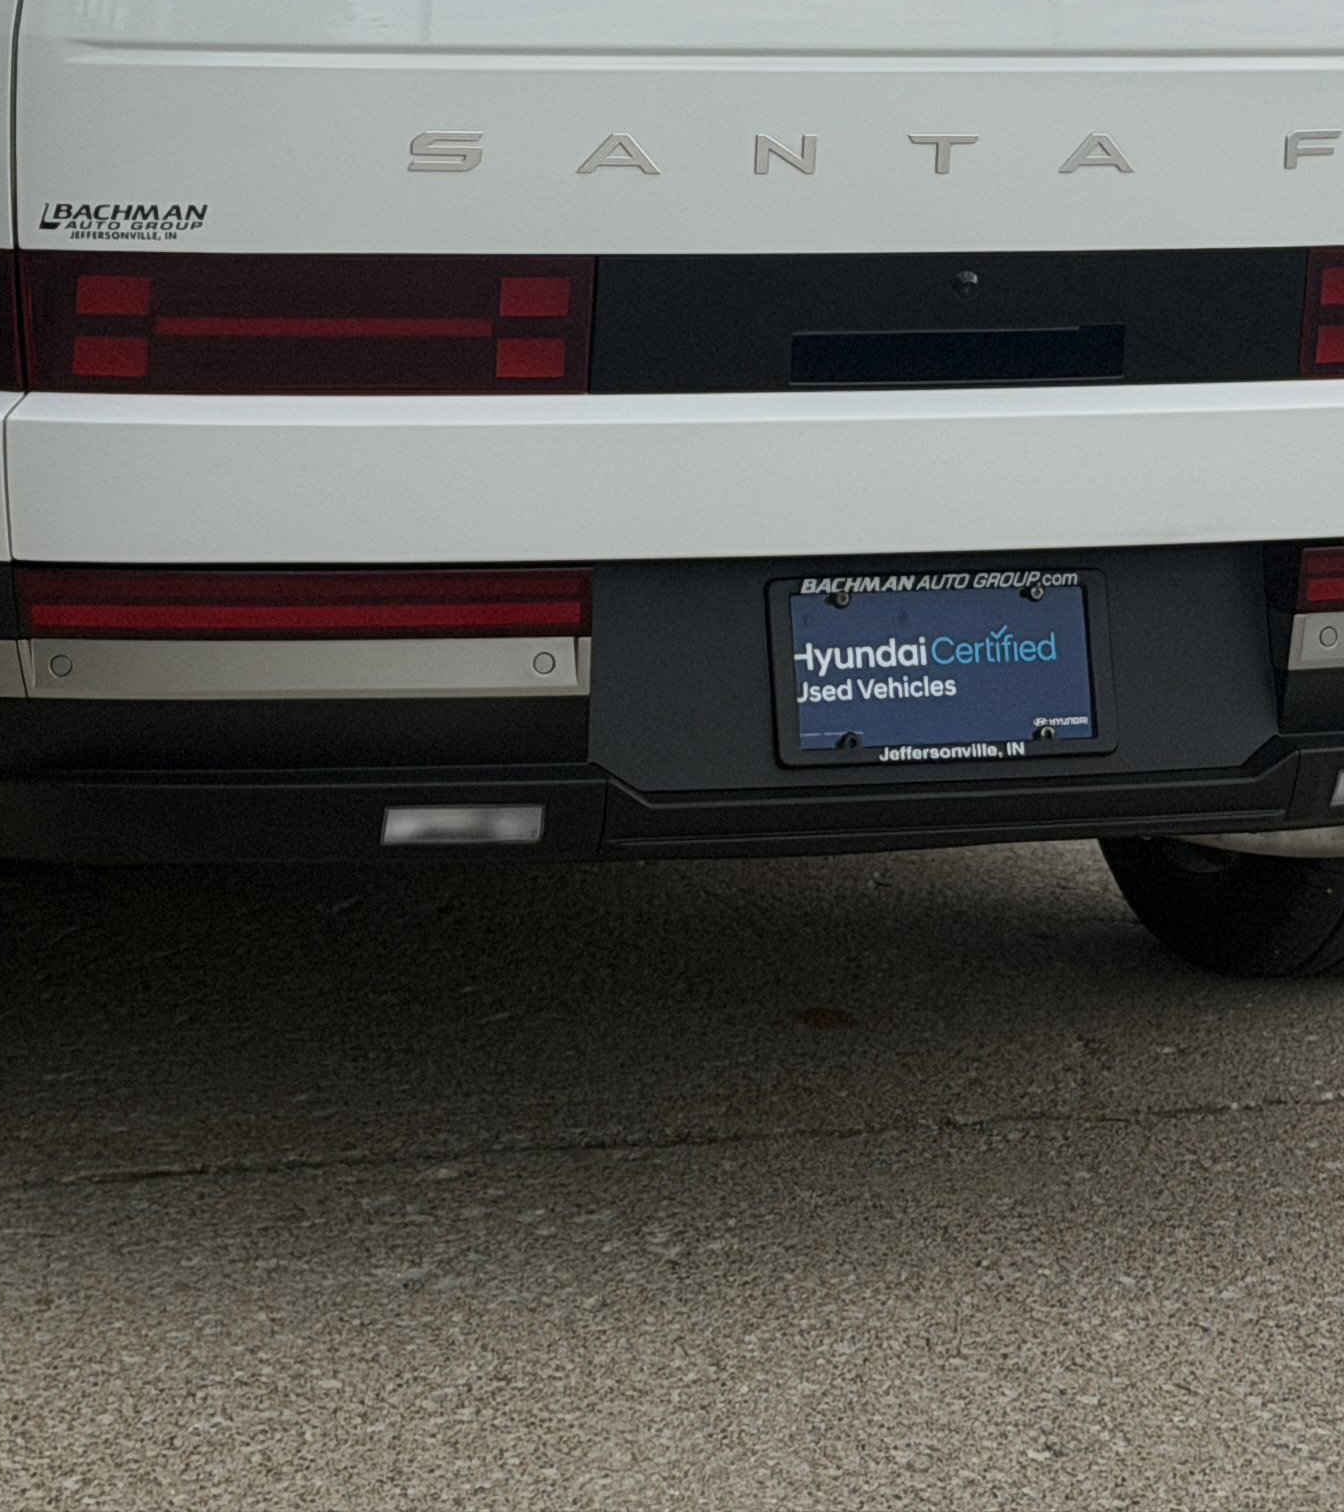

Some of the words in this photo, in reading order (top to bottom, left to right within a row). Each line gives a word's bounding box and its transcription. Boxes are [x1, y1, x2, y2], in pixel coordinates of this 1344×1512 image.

[407, 130, 1135, 174] SANTA
[52, 203, 208, 221] BACHMAN
[64, 221, 121, 231] AUTO
[130, 221, 203, 231] GROUP
[69, 231, 161, 241] JEFFERSONVILLE,
[164, 231, 177, 240] IN
[800, 575, 915, 594] BACHMAN
[915, 573, 969, 591] AUTO
[972, 571, 1078, 589] GROUP.com
[931, 625, 1057, 665] Certified
[857, 676, 956, 700] Vehicles
[1049, 716, 1088, 726] HYUNDAI
[879, 743, 1003, 762] Jeffersonville,
[1007, 742, 1026, 756] IN
